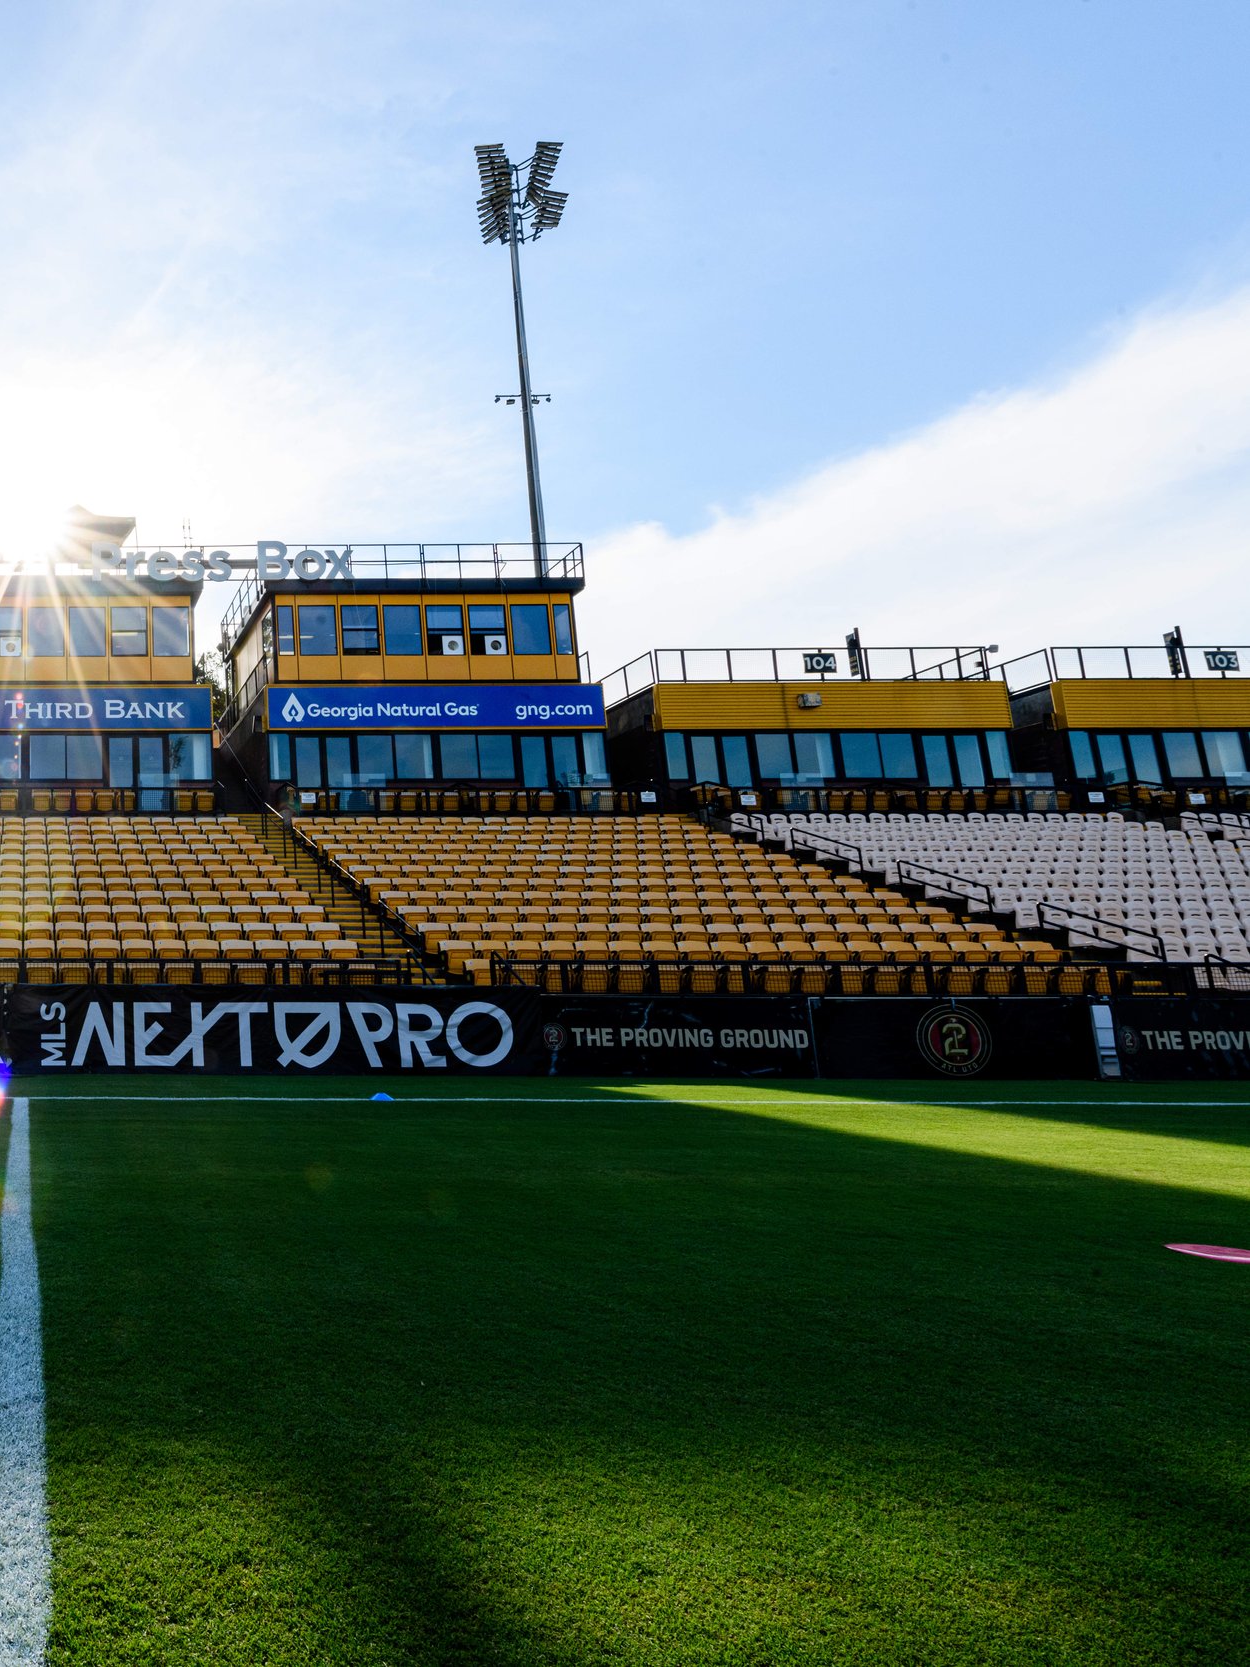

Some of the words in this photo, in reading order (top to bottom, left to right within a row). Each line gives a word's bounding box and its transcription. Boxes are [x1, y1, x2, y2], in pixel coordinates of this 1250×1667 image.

[91, 542, 232, 583] Press
[257, 541, 355, 580] Box
[804, 656, 837, 670] 104
[1206, 654, 1238, 668] 103
[4, 700, 93, 719] THIRD
[104, 700, 185, 719] BANK
[307, 703, 373, 720] Georgia
[377, 702, 441, 717] Natural
[444, 702, 479, 716] Gas
[515, 704, 593, 720] gng.com
[40, 1001, 67, 1066] MLS
[571, 1028, 615, 1047] THE
[620, 1028, 714, 1048] PROVING
[720, 1029, 809, 1049] GROUND
[1141, 1030, 1185, 1049] THE
